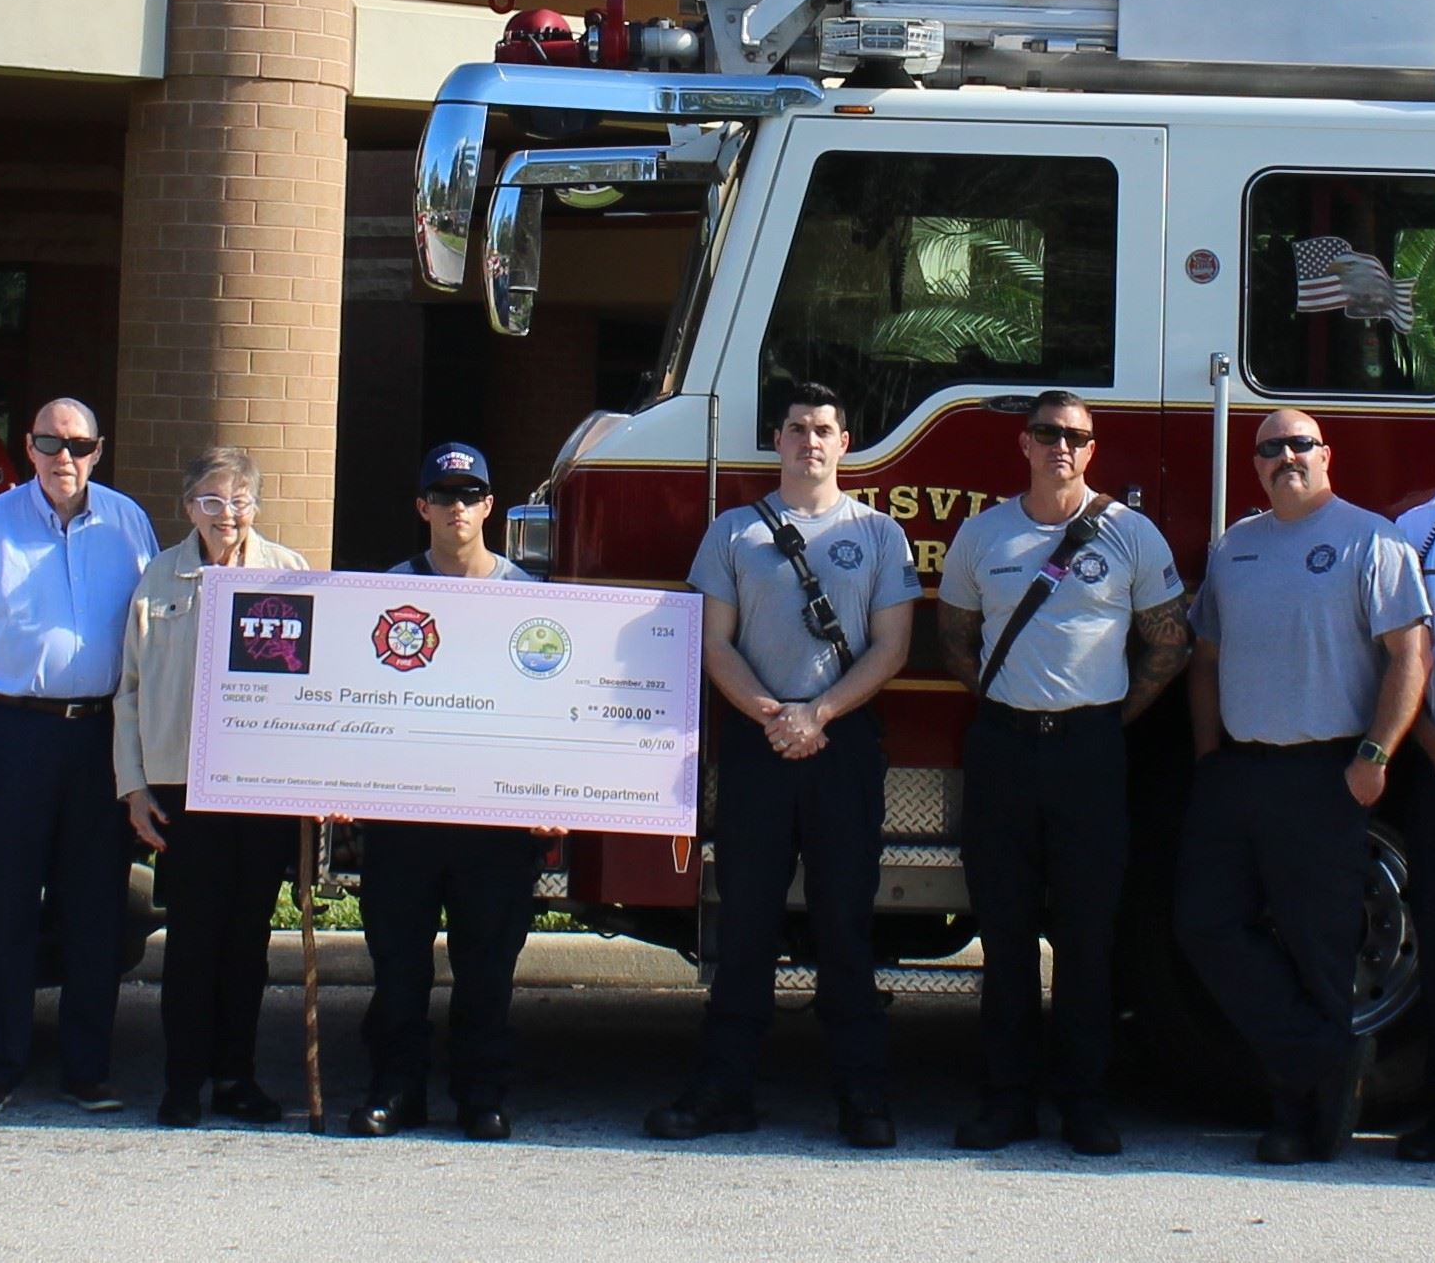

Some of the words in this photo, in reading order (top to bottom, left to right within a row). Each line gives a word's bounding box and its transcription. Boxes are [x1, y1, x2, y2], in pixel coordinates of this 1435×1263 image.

[239, 617, 303, 640] TFD
[651, 627, 675, 637] 1234
[221, 683, 237, 692] PAY
[239, 683, 251, 692] TO
[253, 684, 269, 693] THE
[222, 694, 253, 703] ORDER
[294, 685, 333, 702] Jess
[339, 687, 397, 706] Parrish
[403, 692, 496, 712] Foundation
[570, 706, 579, 722] $
[602, 705, 652, 721] 2000.00
[222, 716, 258, 730] Two
[263, 717, 340, 733] thousand
[340, 720, 396, 736] dollars
[638, 738, 675, 752] 00/100
[494, 781, 550, 796] Titusville
[554, 784, 579, 798] Fire
[583, 786, 660, 803] Department
